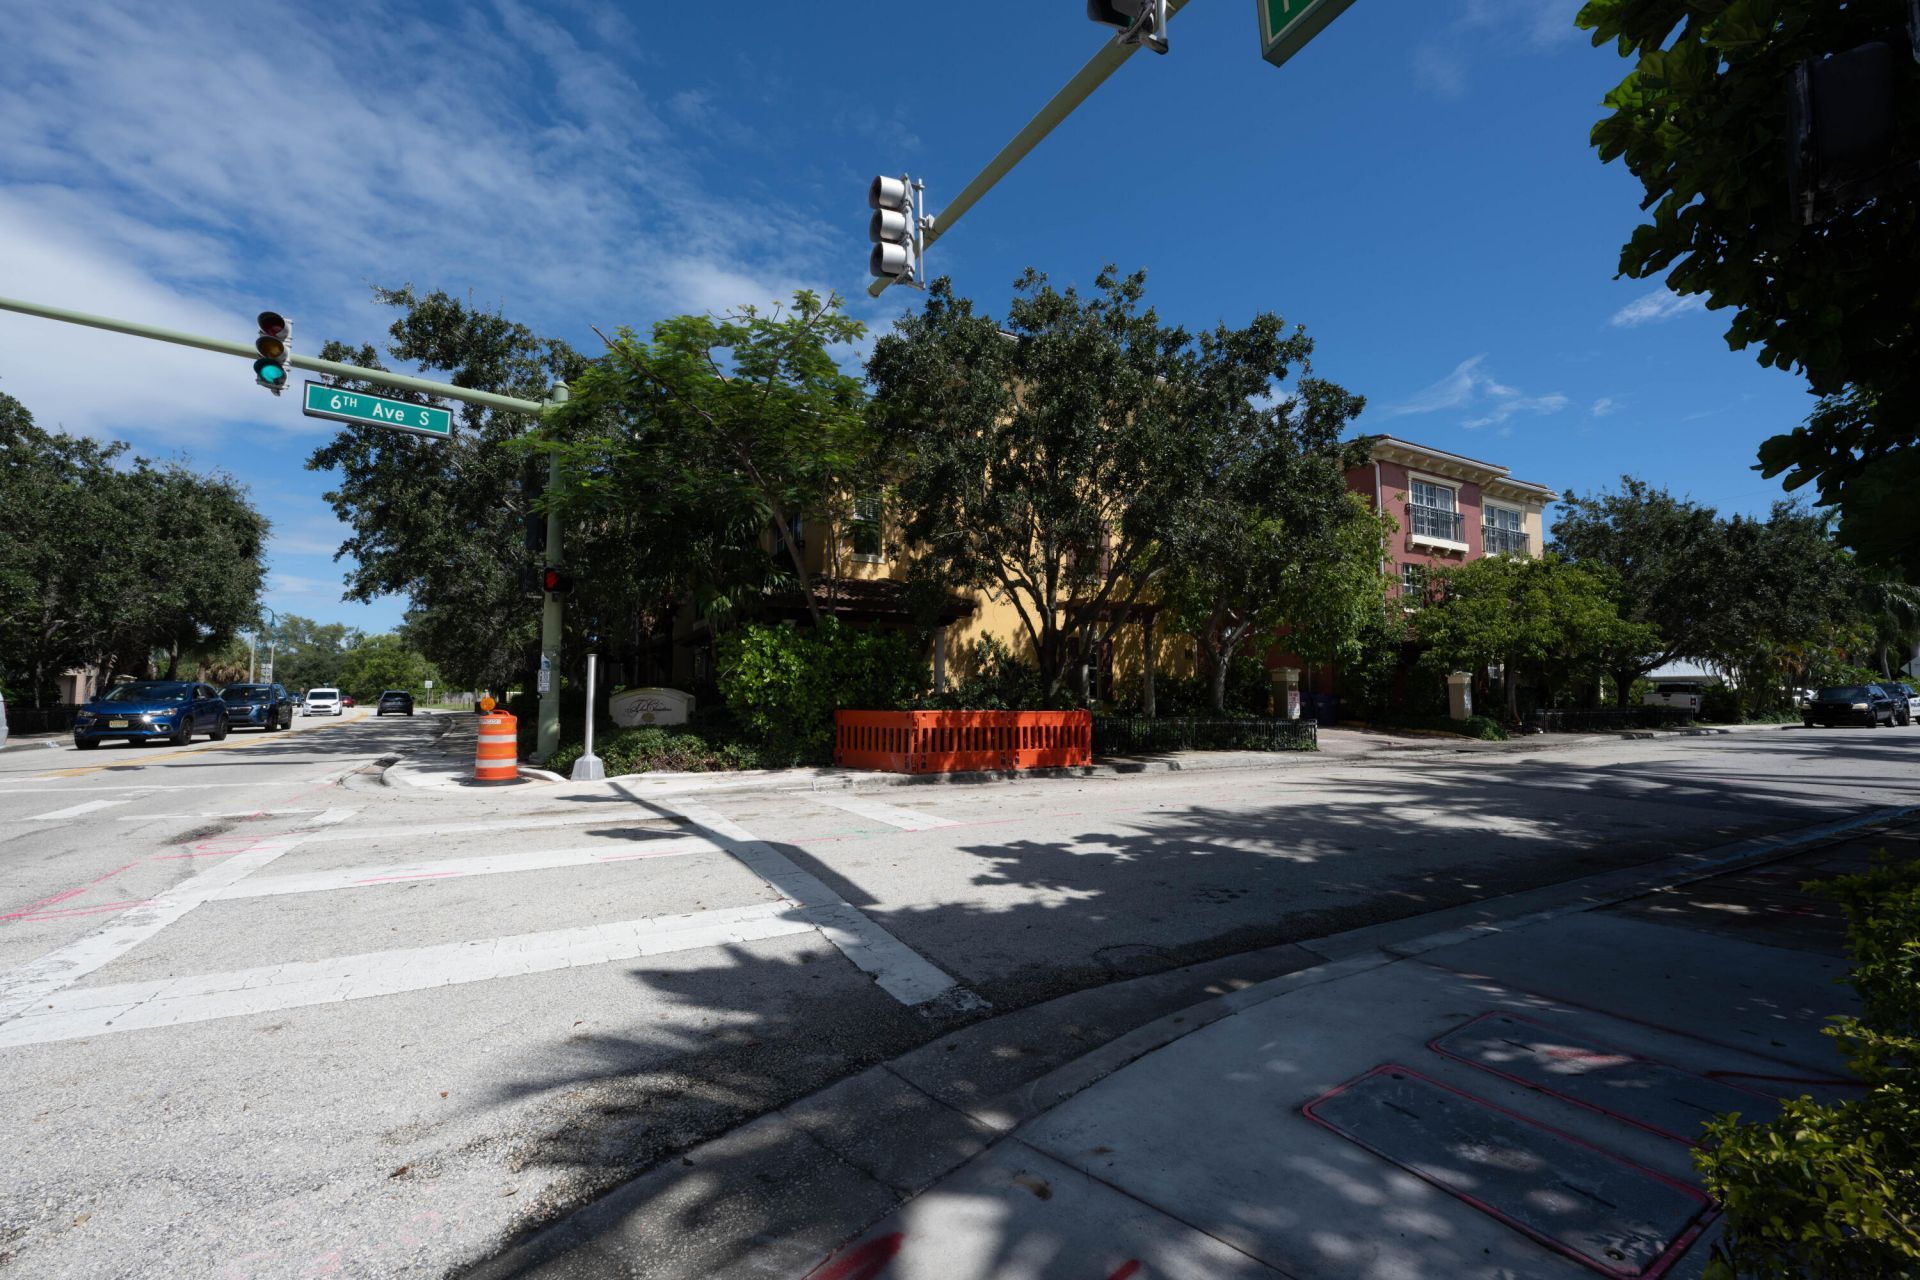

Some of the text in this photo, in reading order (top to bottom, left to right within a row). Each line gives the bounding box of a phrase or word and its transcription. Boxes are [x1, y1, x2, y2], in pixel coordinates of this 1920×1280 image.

[331, 395, 430, 426] 6TH Ave S
